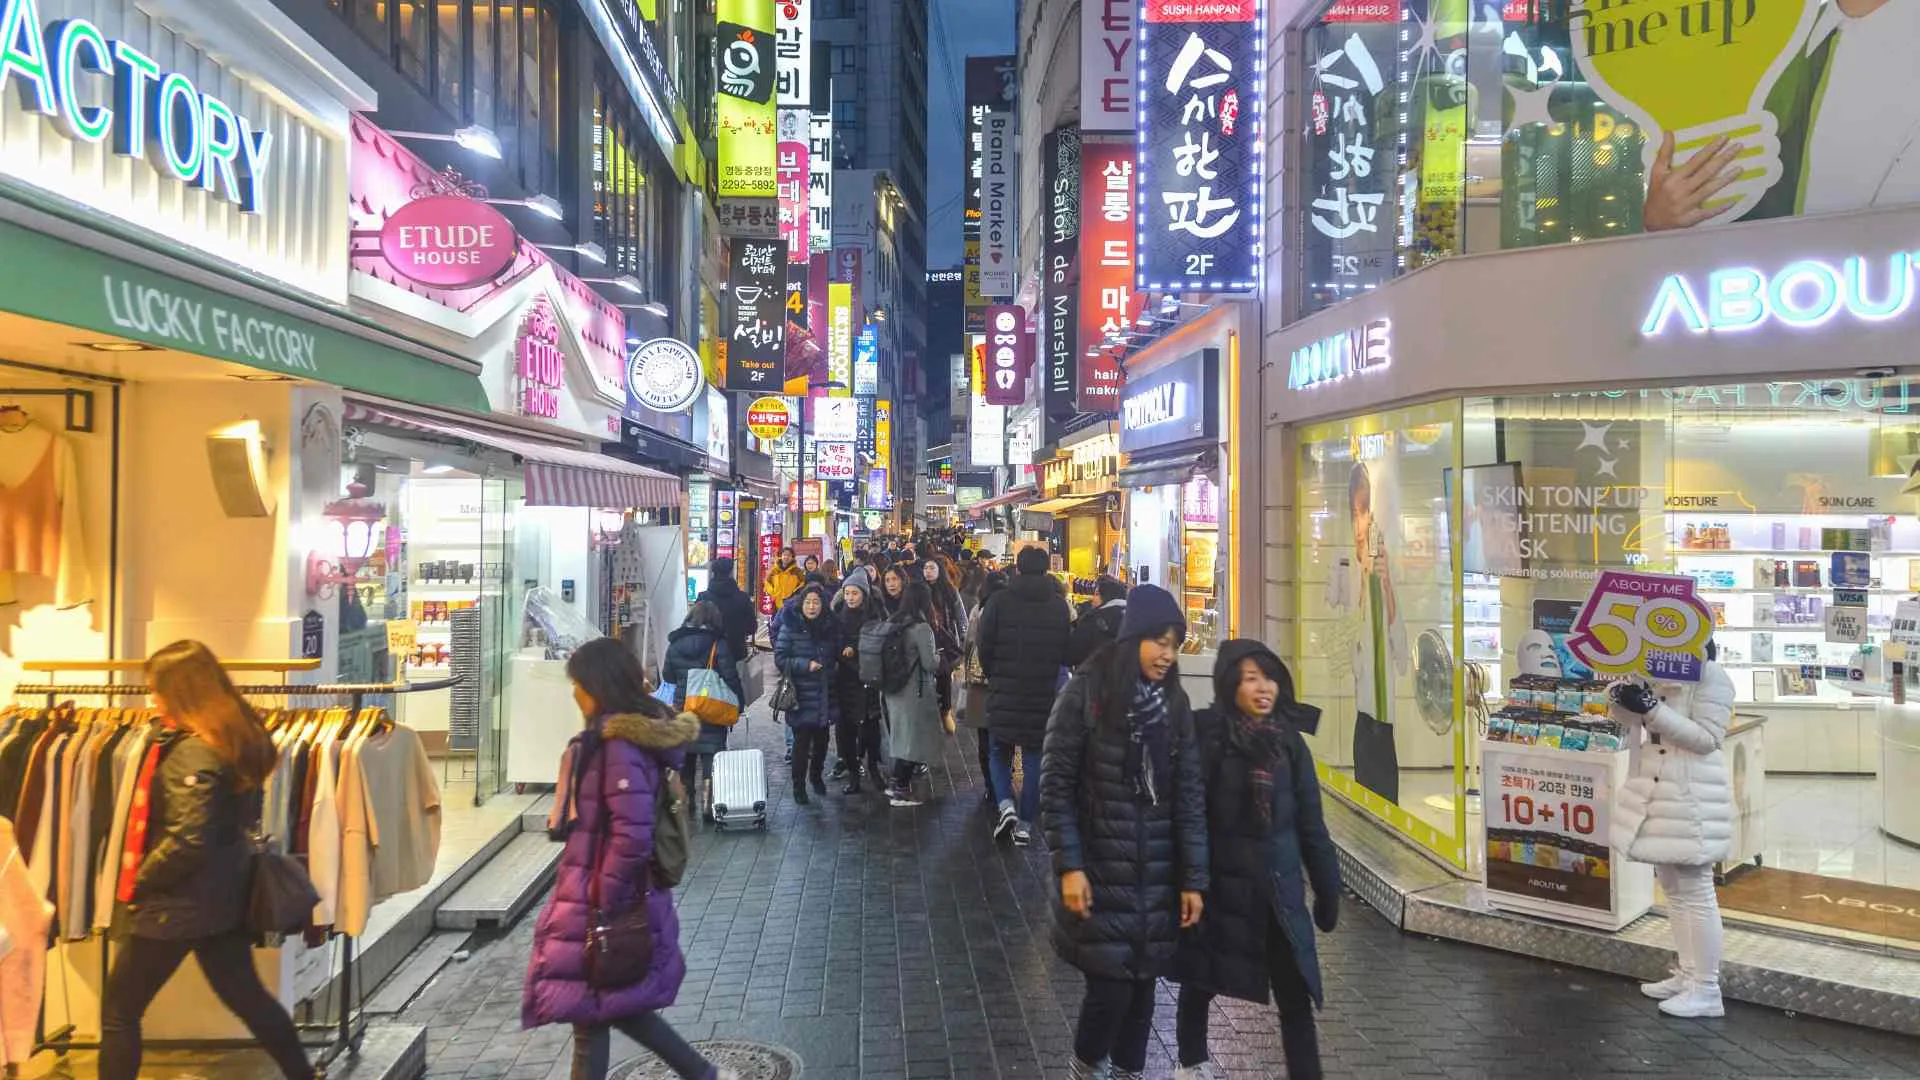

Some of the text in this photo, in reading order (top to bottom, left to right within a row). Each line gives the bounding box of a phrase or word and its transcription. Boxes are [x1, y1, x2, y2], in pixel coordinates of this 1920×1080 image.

[1162, 5, 1241, 16] SUSHI HANPAN
[1584, 0, 1757, 56] me up
[775, 26, 803, 99] 갈비
[722, 179, 775, 190] 2292-5892
[989, 118, 1006, 249] Brand Market
[732, 205, 777, 226] 부동산
[399, 224, 497, 250] ETUDE
[413, 250, 481, 265] HOUSE
[1185, 255, 1214, 275] 2F
[1054, 178, 1070, 392] Salon de Marshall
[1640, 248, 1920, 336] ABOU
[104, 275, 318, 372] LUCKY FACTORY
[524, 337, 567, 389] ETUDE
[1288, 316, 1392, 390] ABOUT ME
[741, 360, 775, 369] Take out
[751, 371, 765, 382] 2F
[527, 388, 562, 419] HOUSE
[1481, 485, 1649, 508] SKIN TONE UP
[1819, 496, 1876, 508] SKIN CARE
[1608, 579, 1685, 597] ABOUT ME
[1838, 593, 1865, 603] VISA
[1646, 649, 1692, 664] BRAND
[1646, 661, 1691, 675] SALE
[1501, 774, 1535, 791] 초특가
[1570, 784, 1594, 799] 만원
[1501, 793, 1595, 835] 10+10
[1528, 878, 1555, 890] ABOUT
